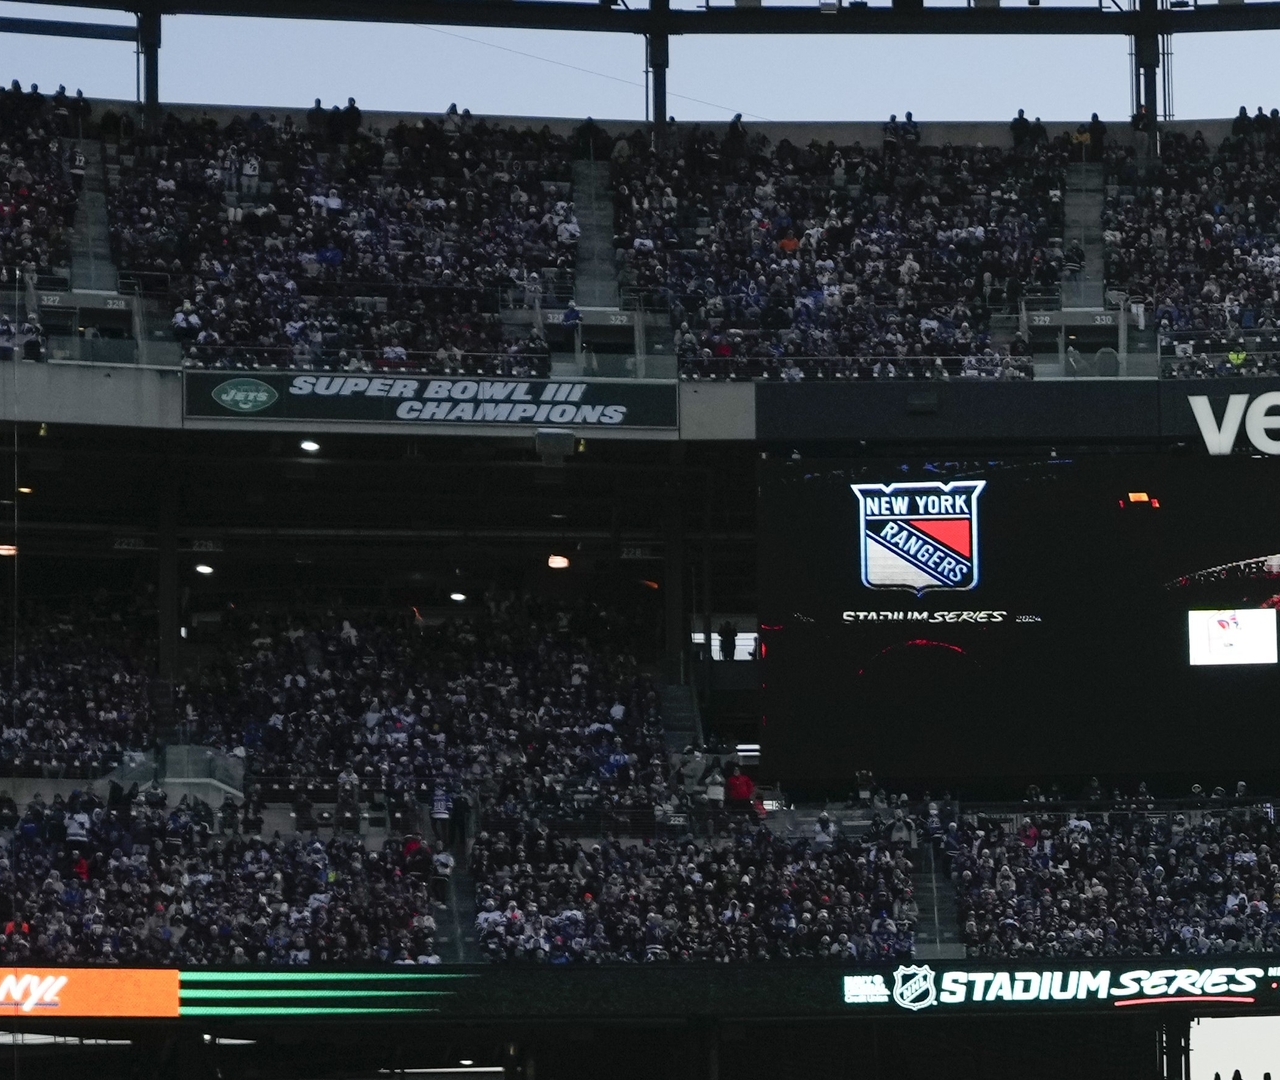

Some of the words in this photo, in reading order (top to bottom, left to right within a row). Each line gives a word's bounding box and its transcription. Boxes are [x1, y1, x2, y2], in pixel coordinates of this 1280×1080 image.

[41, 296, 60, 304] 327
[1034, 316, 1050, 324] 329
[1095, 315, 1112, 325] 330
[221, 388, 268, 402] JETS
[289, 376, 419, 399] SUPER
[423, 380, 534, 401] BOWL
[539, 383, 587, 402] III
[395, 401, 628, 424] CHAMPIONS
[866, 496, 911, 516] NEW
[915, 494, 970, 515] YORK
[879, 520, 970, 584] RANGERS
[929, 610, 1008, 623] SERIES
[902, 976, 928, 1000] NHL
[940, 970, 1109, 1002] STADIUM
[1110, 967, 1264, 996] SERIES
